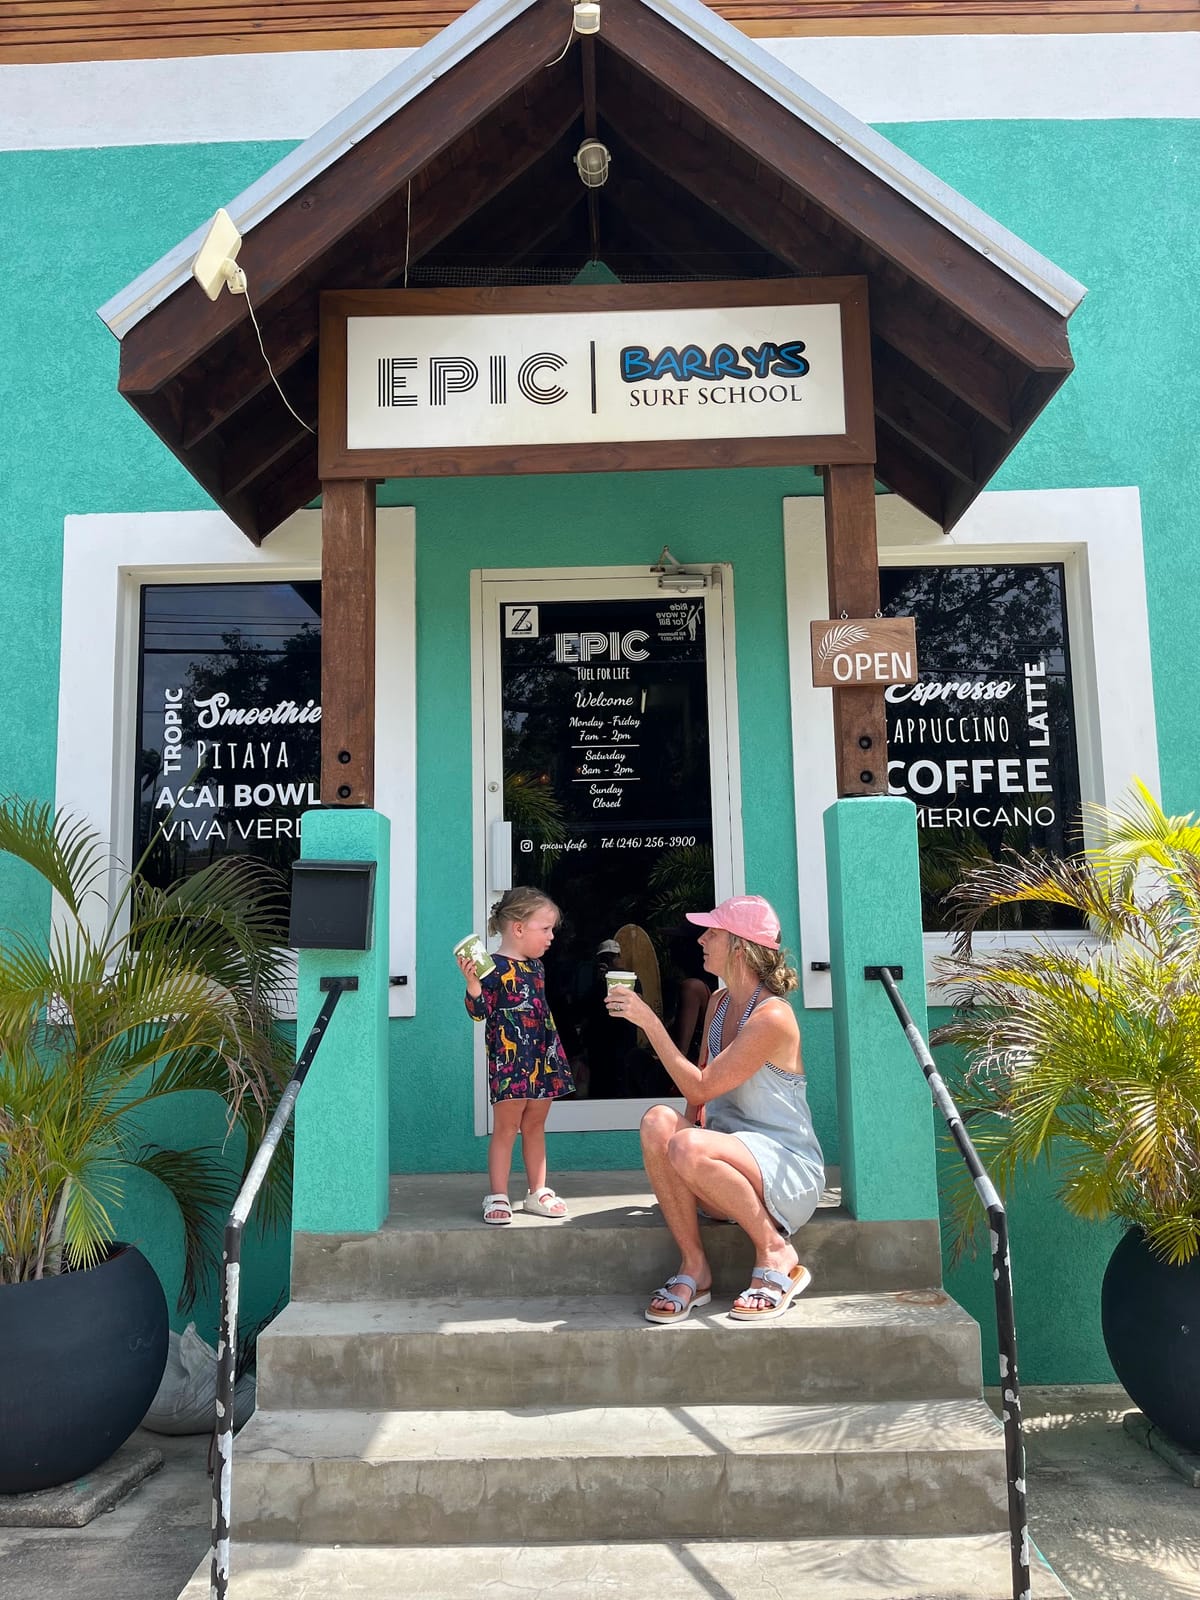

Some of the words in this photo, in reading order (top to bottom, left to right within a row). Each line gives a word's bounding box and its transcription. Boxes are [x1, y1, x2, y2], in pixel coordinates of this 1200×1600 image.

[620, 341, 810, 383] BARRY'S
[377, 352, 569, 407] EPIC
[629, 388, 690, 407] SURF
[697, 384, 803, 404] SCHOOL
[555, 629, 650, 662] EPIC
[577, 667, 595, 681] FUEL
[597, 667, 611, 681] FOR
[613, 667, 631, 680] LIFE
[832, 651, 913, 681] OPEN
[574, 691, 634, 709] Welcome
[884, 681, 1016, 706] Espresso
[1024, 661, 1050, 748] LATTE
[193, 692, 322, 729] Smoothie
[568, 716, 604, 729] Monday
[163, 688, 183, 776] TROPIC
[580, 730, 599, 741] 7am
[611, 729, 631, 742] 2pm
[886, 716, 1010, 744] APPUCCINO
[197, 740, 289, 769] PITAYA
[585, 750, 626, 763] Saturday
[581, 764, 601, 775] 8am
[613, 763, 634, 776] 2pm
[887, 758, 1053, 795] COFFEE
[155, 785, 224, 809] ACAI
[234, 783, 322, 807] BOWL
[589, 784, 623, 796] Sunday
[592, 797, 622, 809] Closed
[158, 820, 226, 842] VIVA
[616, 838, 642, 849] (246)
[644, 835, 696, 848] 256-3900
[540, 839, 588, 852] epicsurfcafe
